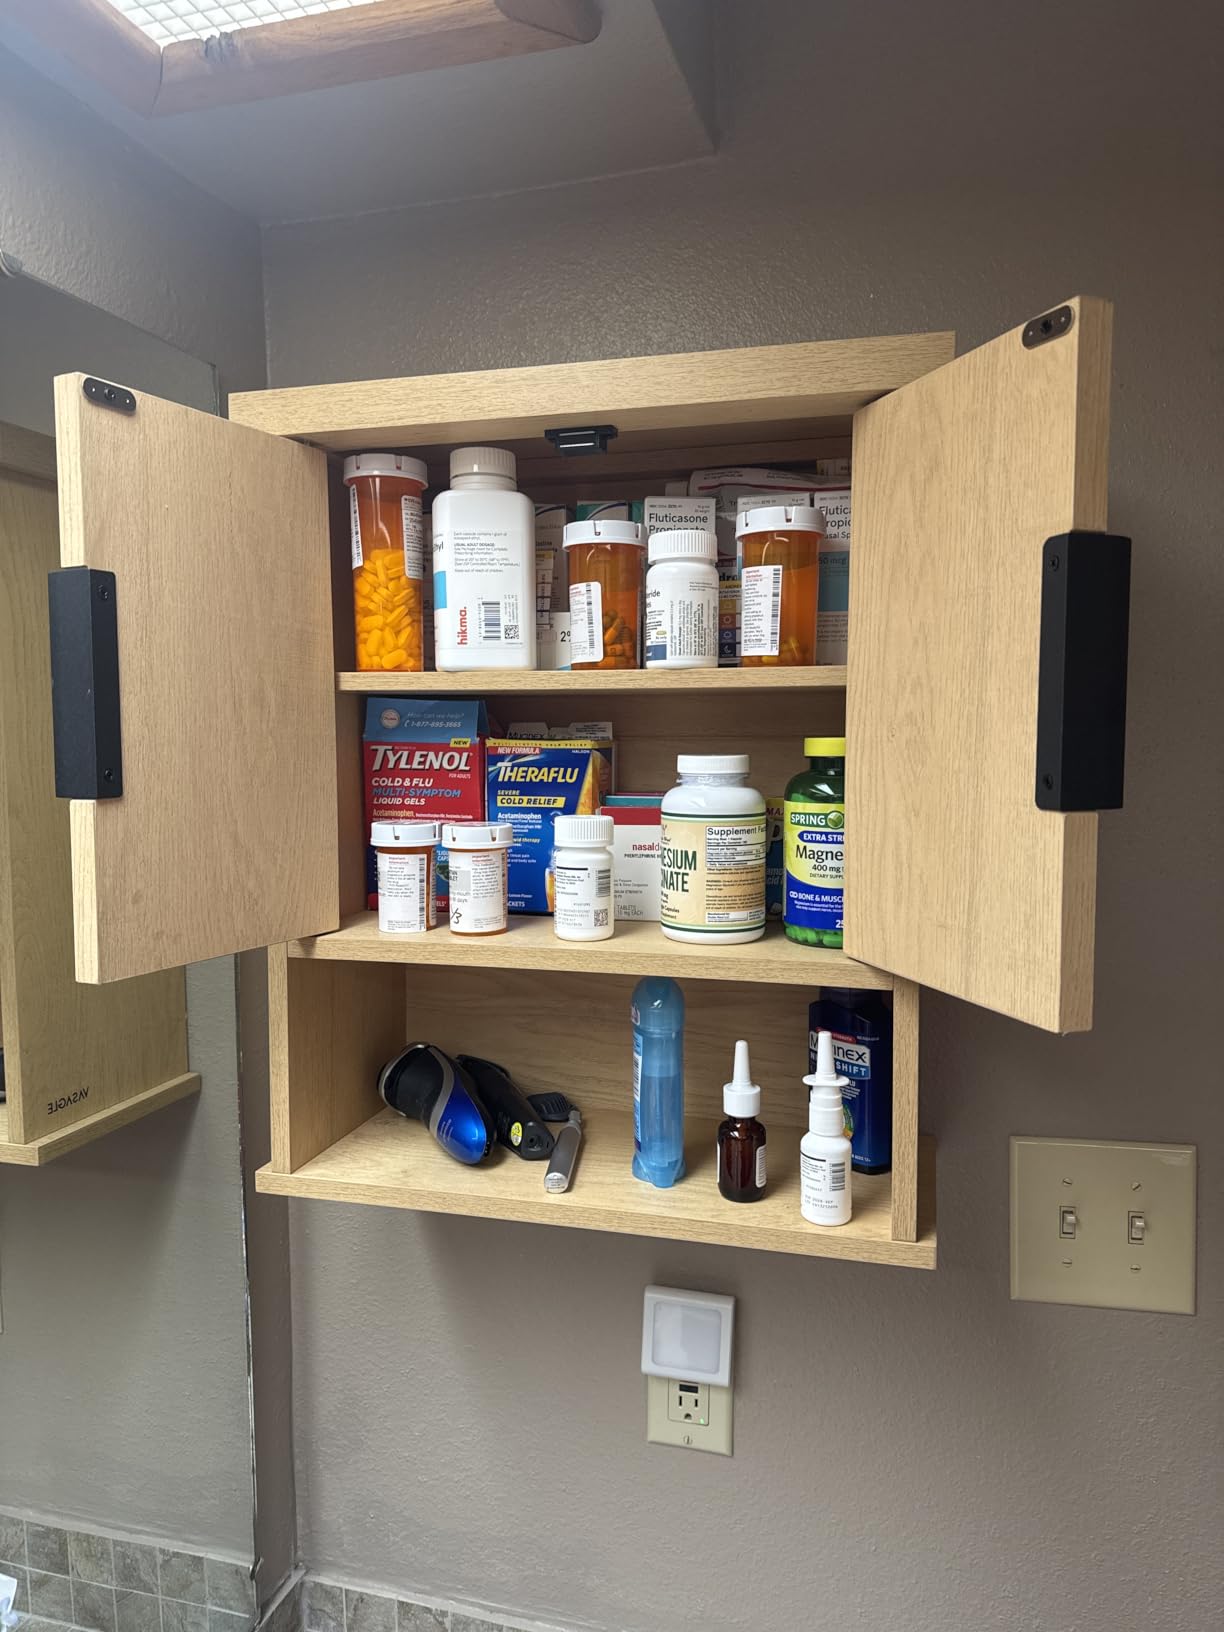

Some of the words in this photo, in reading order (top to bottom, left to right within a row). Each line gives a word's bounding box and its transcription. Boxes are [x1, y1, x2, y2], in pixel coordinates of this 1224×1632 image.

[649, 512, 709, 523] Fluticasone
[825, 517, 851, 530] ropi
[457, 606, 468, 645] hikma.
[497, 746, 512, 754] NEW
[370, 745, 472, 772] TYLENOL
[497, 762, 579, 783] THERAFLU
[372, 777, 402, 787] COLD
[403, 778, 411, 787] &
[412, 778, 433, 787] FLU
[373, 788, 462, 798] MULTI-SYMPTOM
[373, 797, 403, 806] LIQUID
[500, 797, 524, 805] COLD
[526, 798, 558, 806] RELIEF
[497, 812, 542, 820] Acetaminophen
[791, 813, 825, 826] SPRING
[707, 827, 757, 837] Supplement
[803, 833, 826, 841] EXTRA
[827, 834, 844, 842] STR
[795, 844, 844, 864] Magne
[812, 864, 828, 872] 400
[828, 865, 841, 873] mg
[798, 892, 814, 901] BONE
[814, 894, 820, 902] &
[821, 895, 843, 903] MUSC
